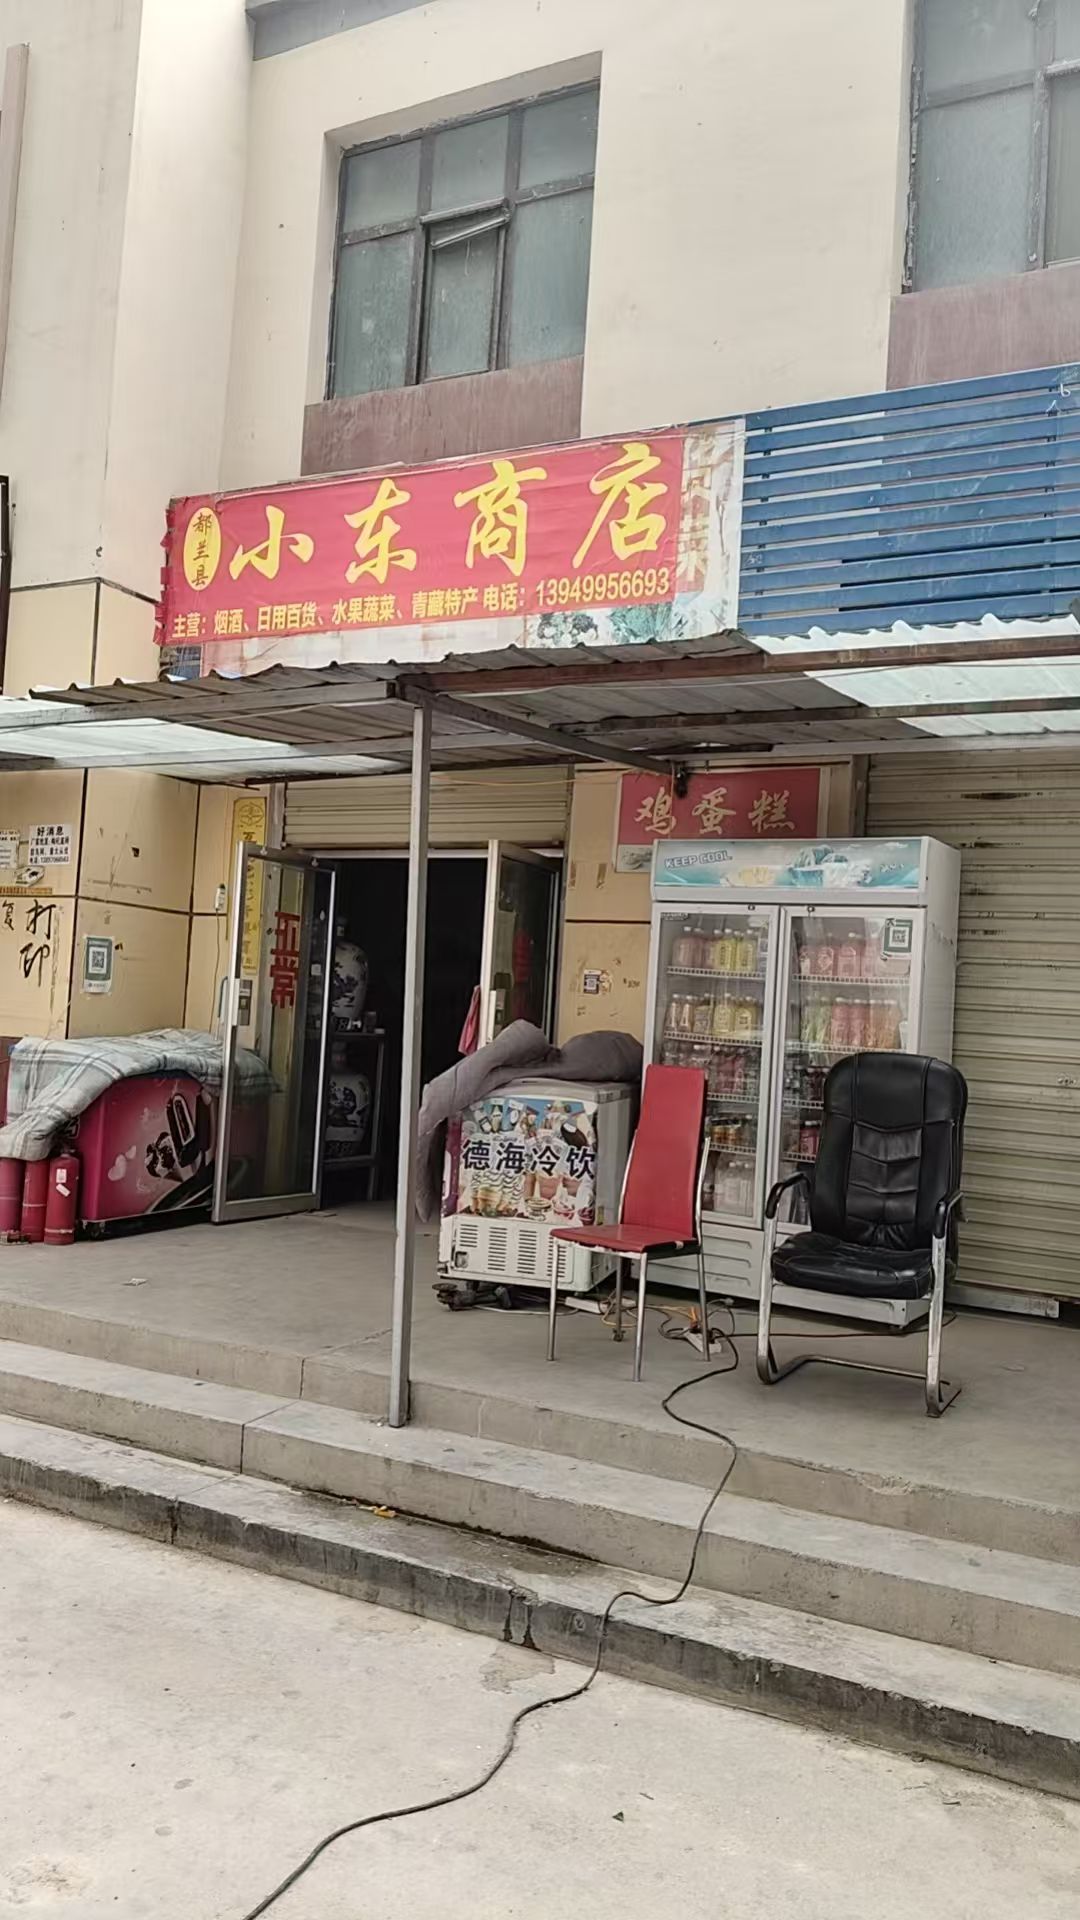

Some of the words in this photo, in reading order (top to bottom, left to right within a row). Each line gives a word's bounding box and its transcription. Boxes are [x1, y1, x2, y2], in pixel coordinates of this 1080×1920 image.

[229, 442, 668, 585] 小东商店
[191, 512, 213, 587] 都兰县
[634, 786, 796, 836] 鸡蛋糕
[664, 855, 698, 870] KEEP
[19, 899, 56, 987] 打印
[462, 1140, 596, 1180] 德海冷饮
